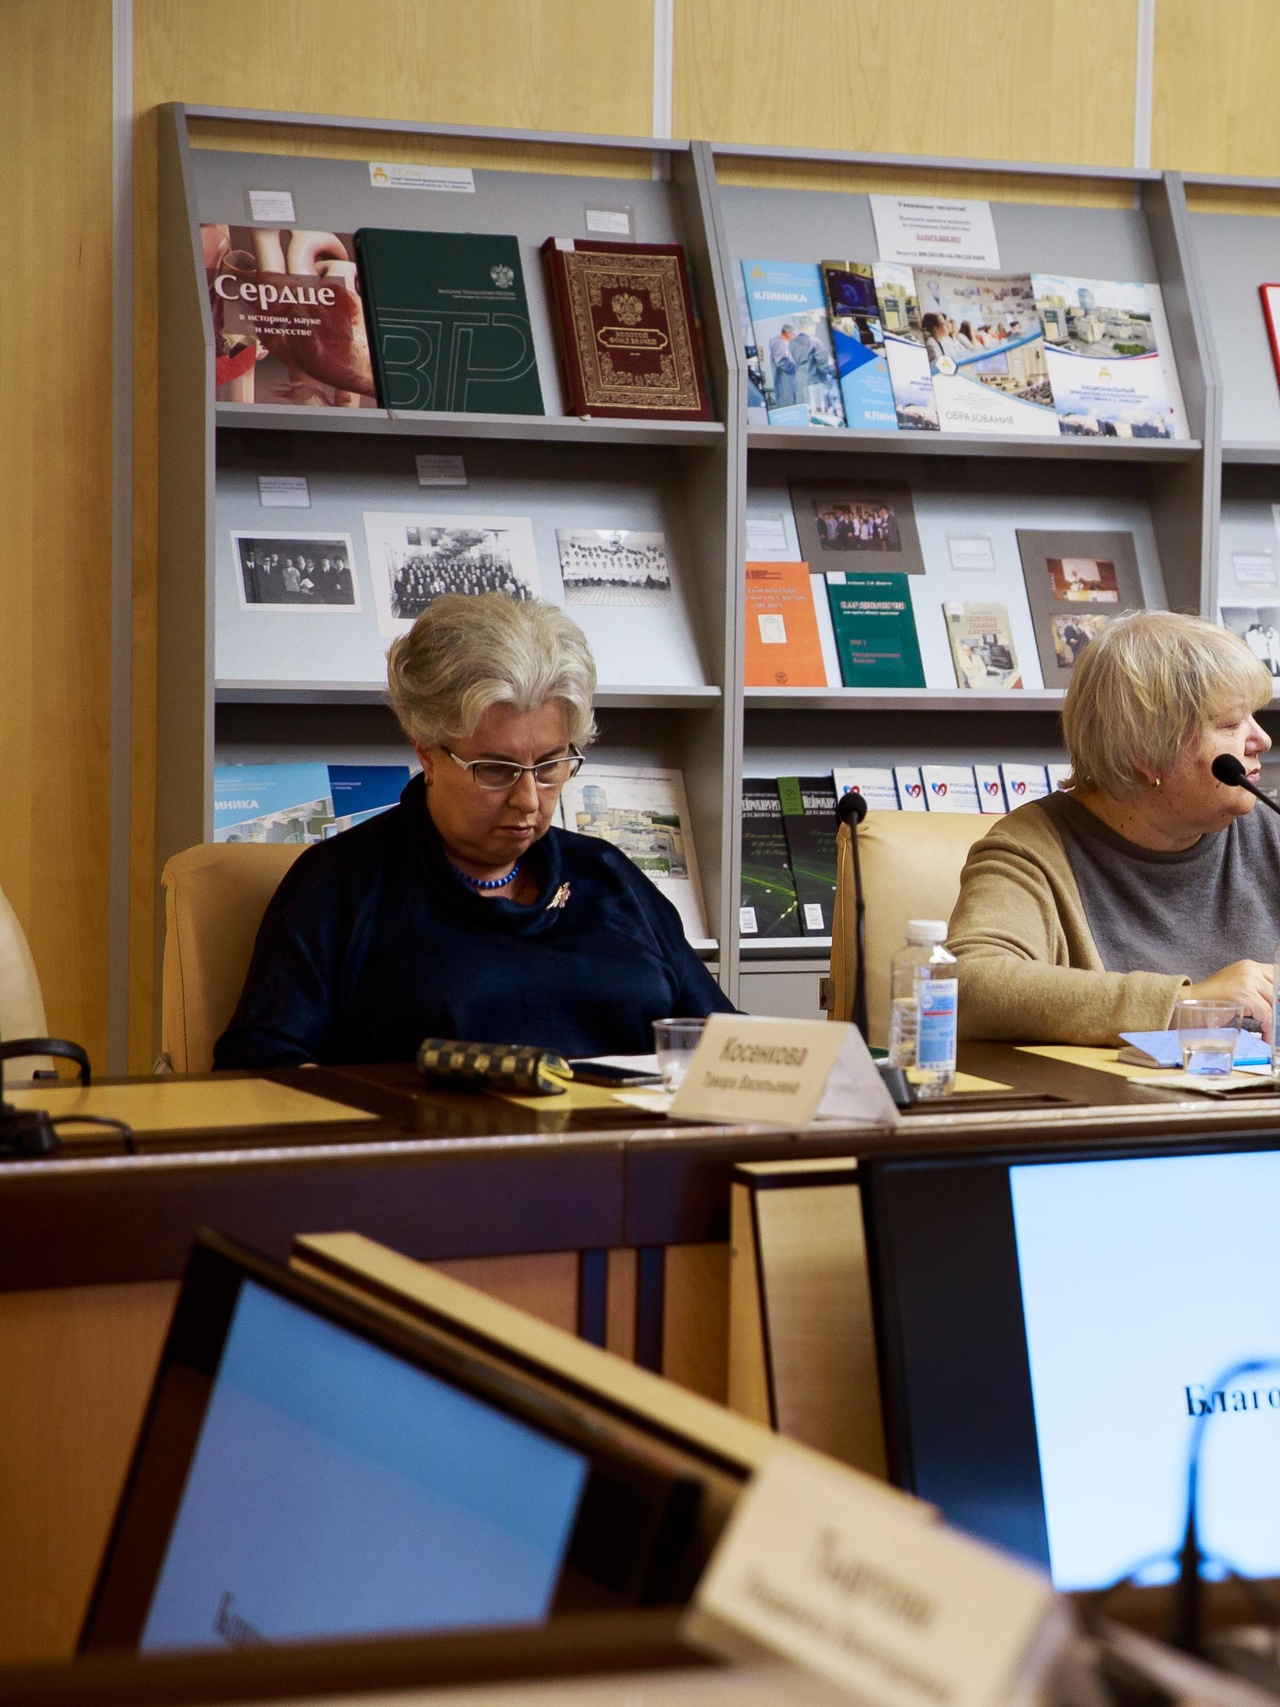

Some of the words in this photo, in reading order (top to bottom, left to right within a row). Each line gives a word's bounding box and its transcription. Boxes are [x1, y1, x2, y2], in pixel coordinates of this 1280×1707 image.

[214, 274, 336, 311] Сердце
[753, 290, 808, 303] КЛИНИКА
[247, 314, 291, 324] истории,
[293, 316, 321, 325] науке
[264, 327, 312, 337] искусстве
[945, 410, 1015, 425] ОБРАЗОВАНИЕ
[214, 800, 259, 810] ИНИКА
[719, 1036, 808, 1067] Косенкова
